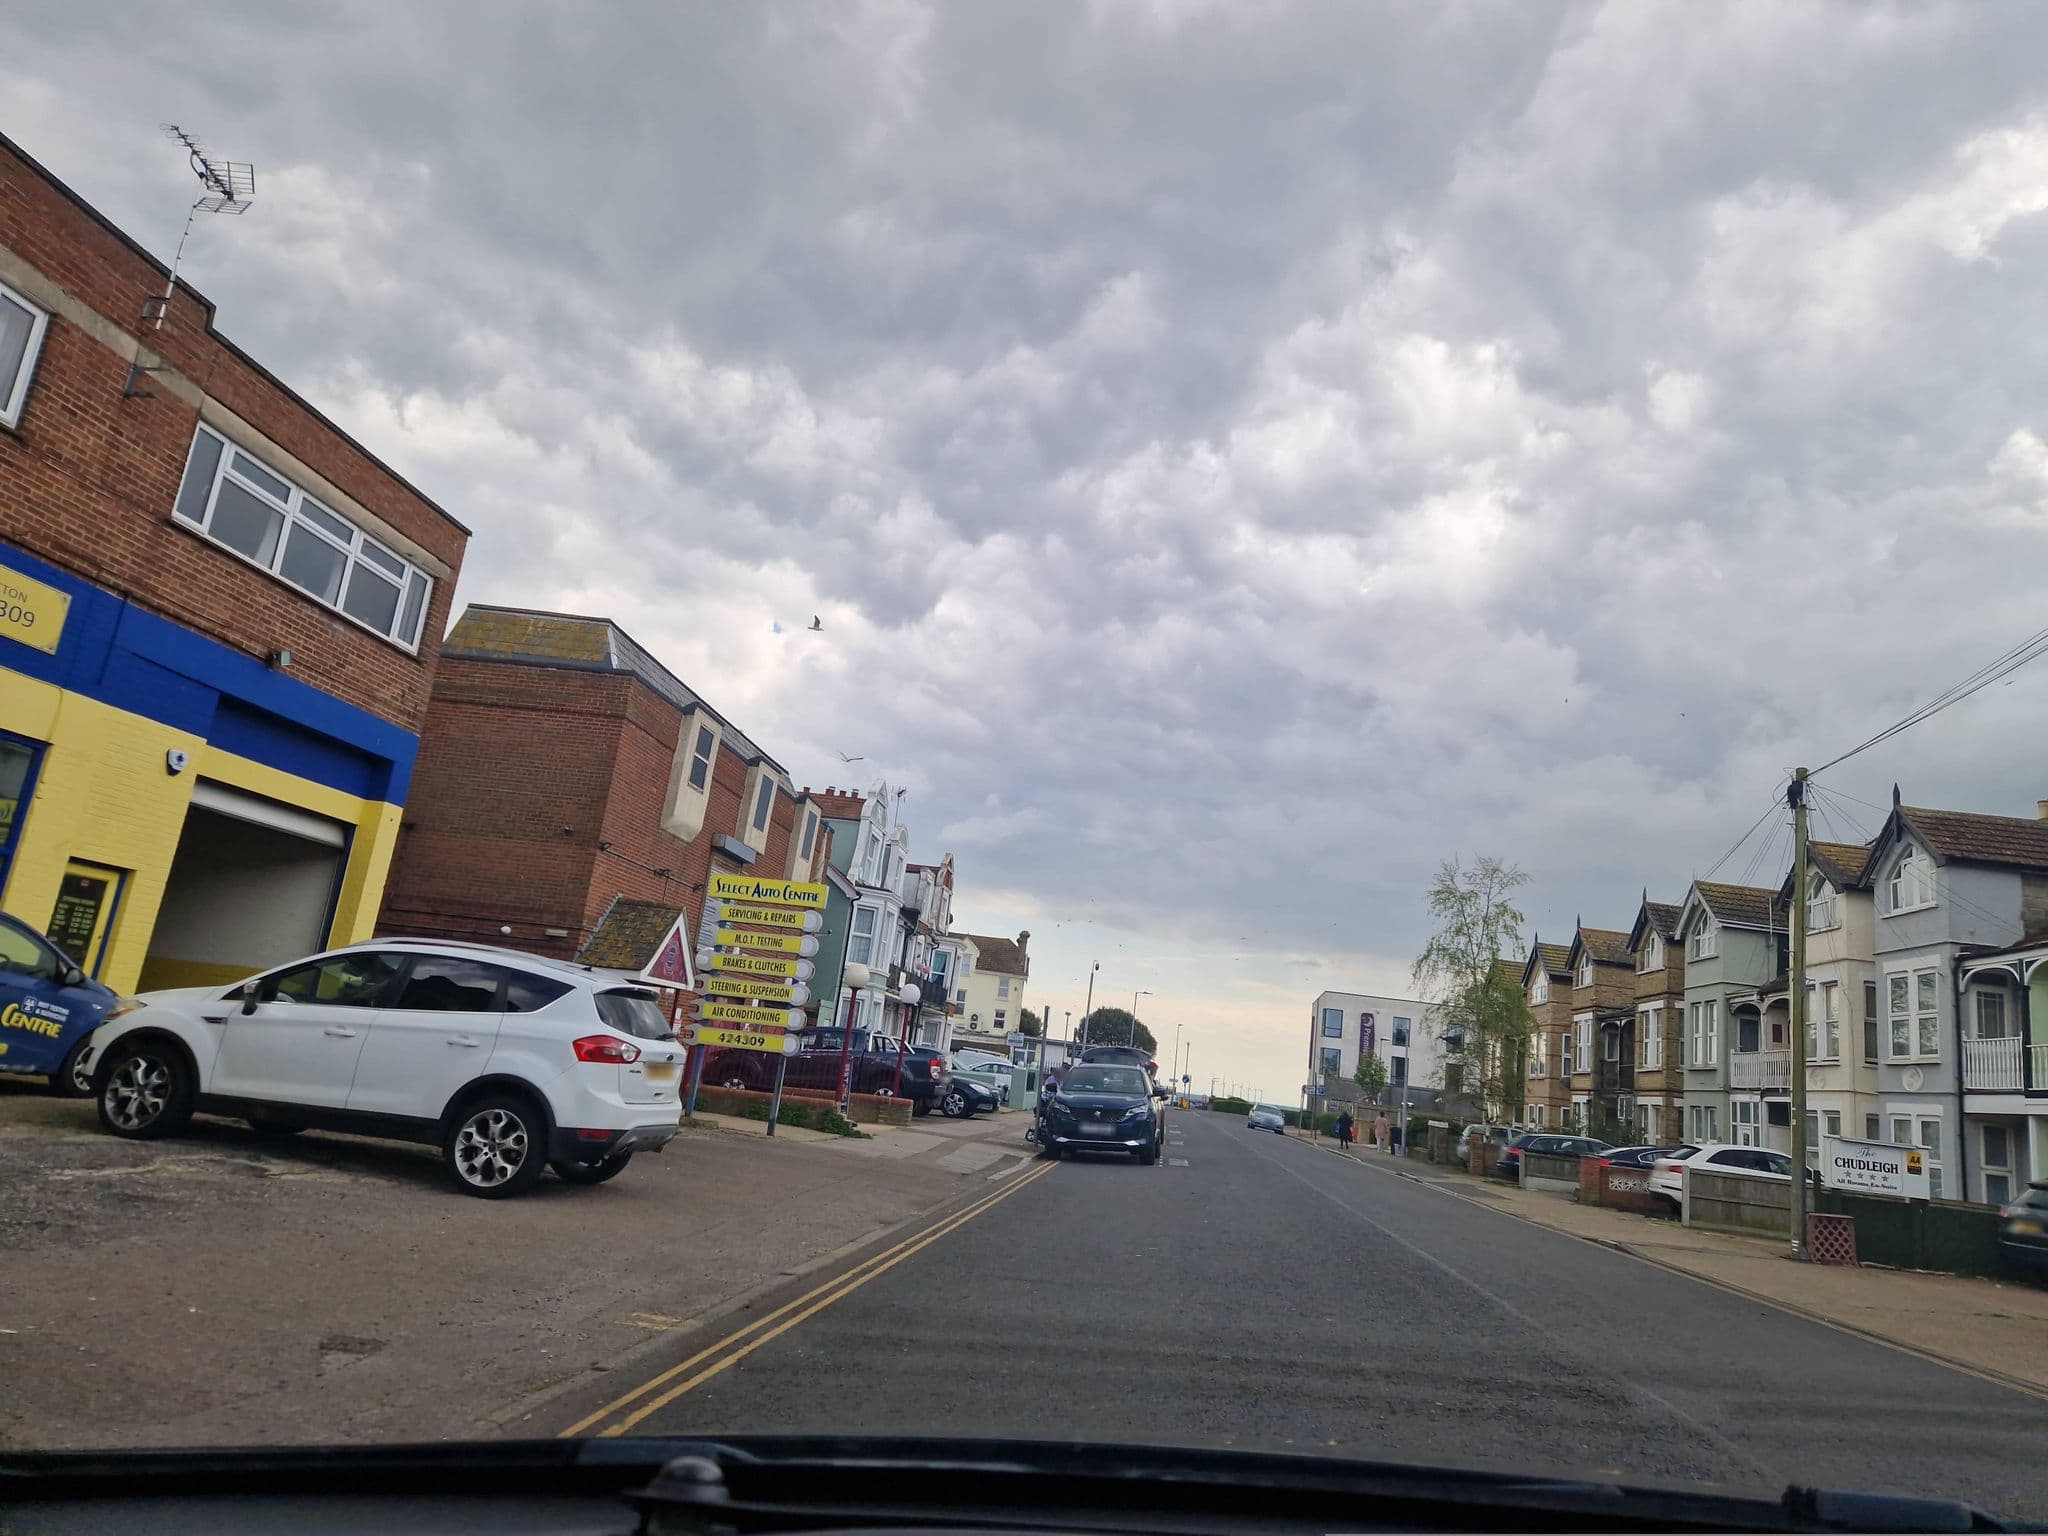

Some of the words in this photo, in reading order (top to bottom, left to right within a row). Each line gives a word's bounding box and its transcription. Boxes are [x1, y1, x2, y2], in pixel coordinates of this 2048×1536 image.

[0, 583, 28, 603] TON
[716, 878, 751, 894] SELECT
[752, 882, 781, 899] AUTO
[783, 885, 820, 902] CENTRE
[728, 908, 762, 920] SERVICING
[763, 912, 769, 920] &
[771, 912, 796, 924] REPAIRS
[734, 934, 755, 945] M.O.T.
[756, 936, 783, 948] TESTING
[722, 957, 747, 969] BRAKES
[747, 960, 753, 970] &
[754, 960, 786, 972] CLUTCHES
[711, 981, 742, 993] STEERING
[742, 984, 748, 994] &
[749, 985, 790, 998] SUSPENSION
[1, 1003, 63, 1038] CENTRE
[712, 1008, 725, 1017] AIR
[726, 1008, 780, 1023] CONDITIONING
[718, 1033, 765, 1047] 424309
[1834, 1157, 1899, 1174] CHUDLEIGH
